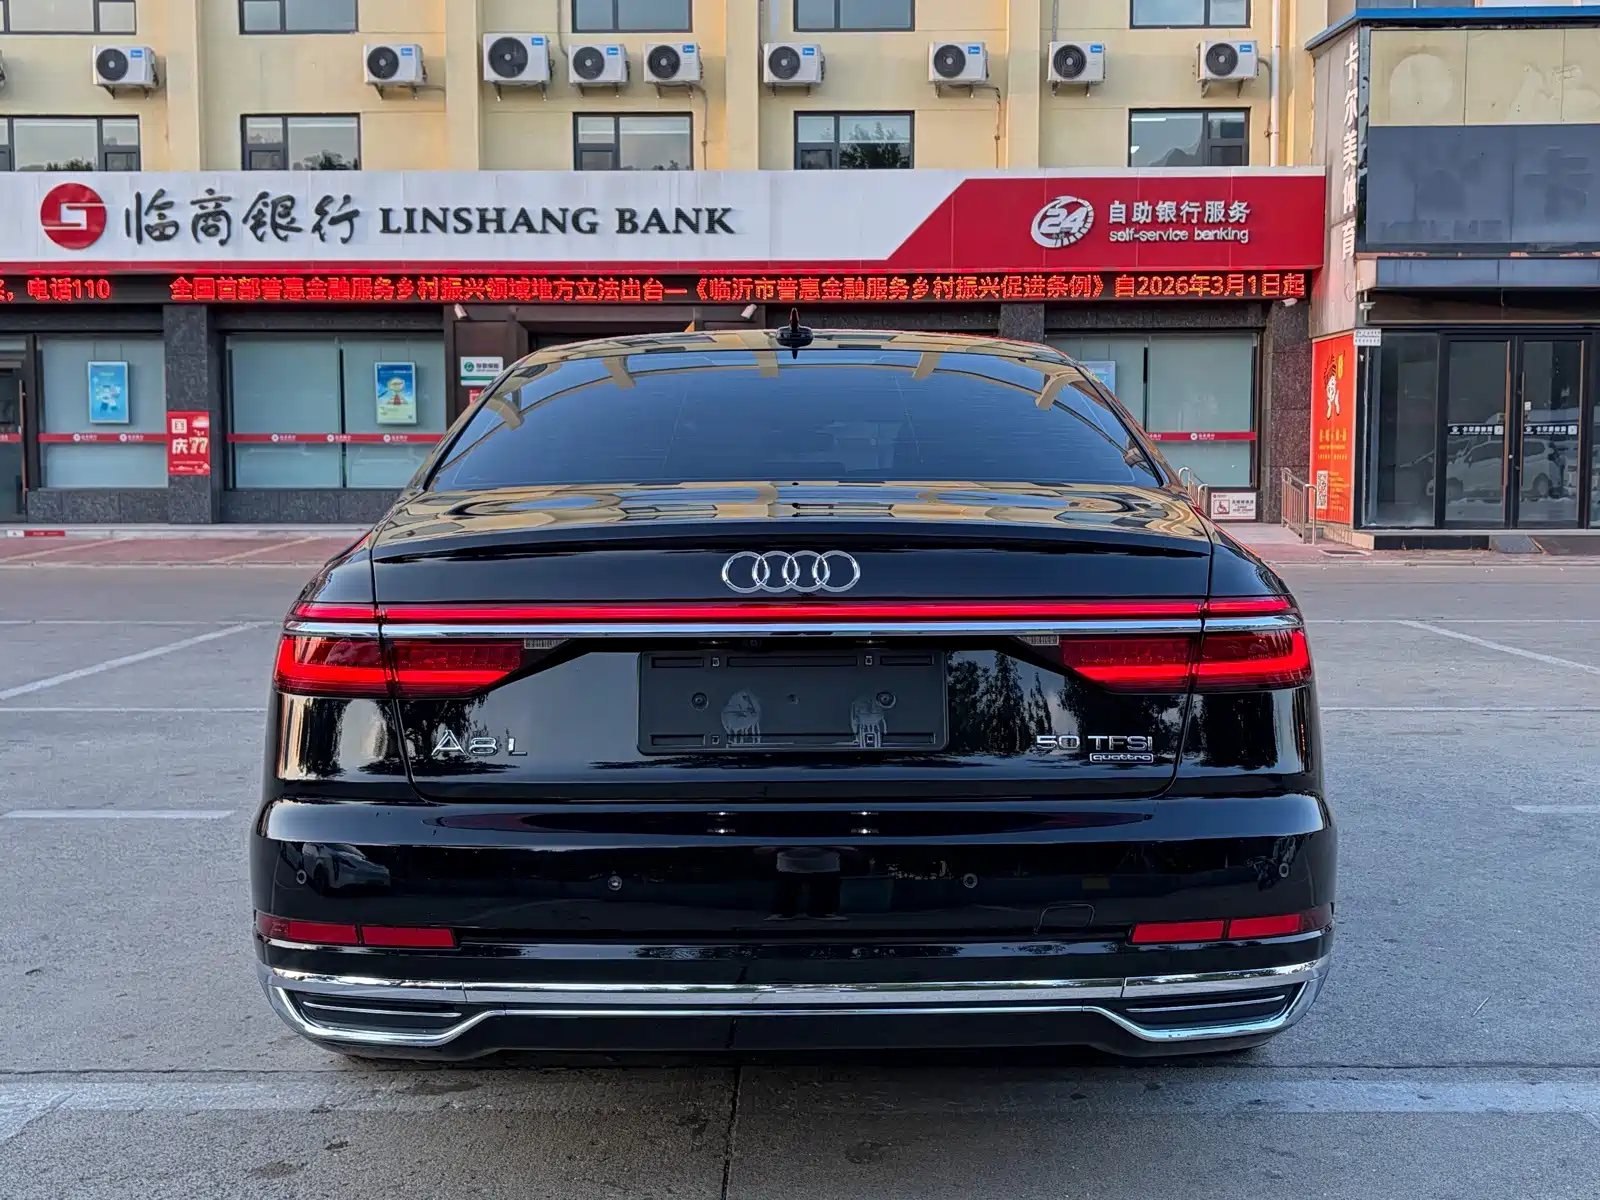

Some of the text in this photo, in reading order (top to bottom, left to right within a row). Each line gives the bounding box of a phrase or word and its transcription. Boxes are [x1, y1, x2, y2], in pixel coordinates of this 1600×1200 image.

[124, 188, 360, 245] 临商银行
[379, 207, 735, 234] LINSHANG BANK
[1040, 206, 1088, 233] 24
[1108, 200, 1251, 224] 自助银行服务
[1109, 227, 1249, 243] self-service banking
[431, 729, 528, 756] A8 L
[1036, 735, 1153, 751] 50 TFSI
[1092, 753, 1151, 762] quattro
